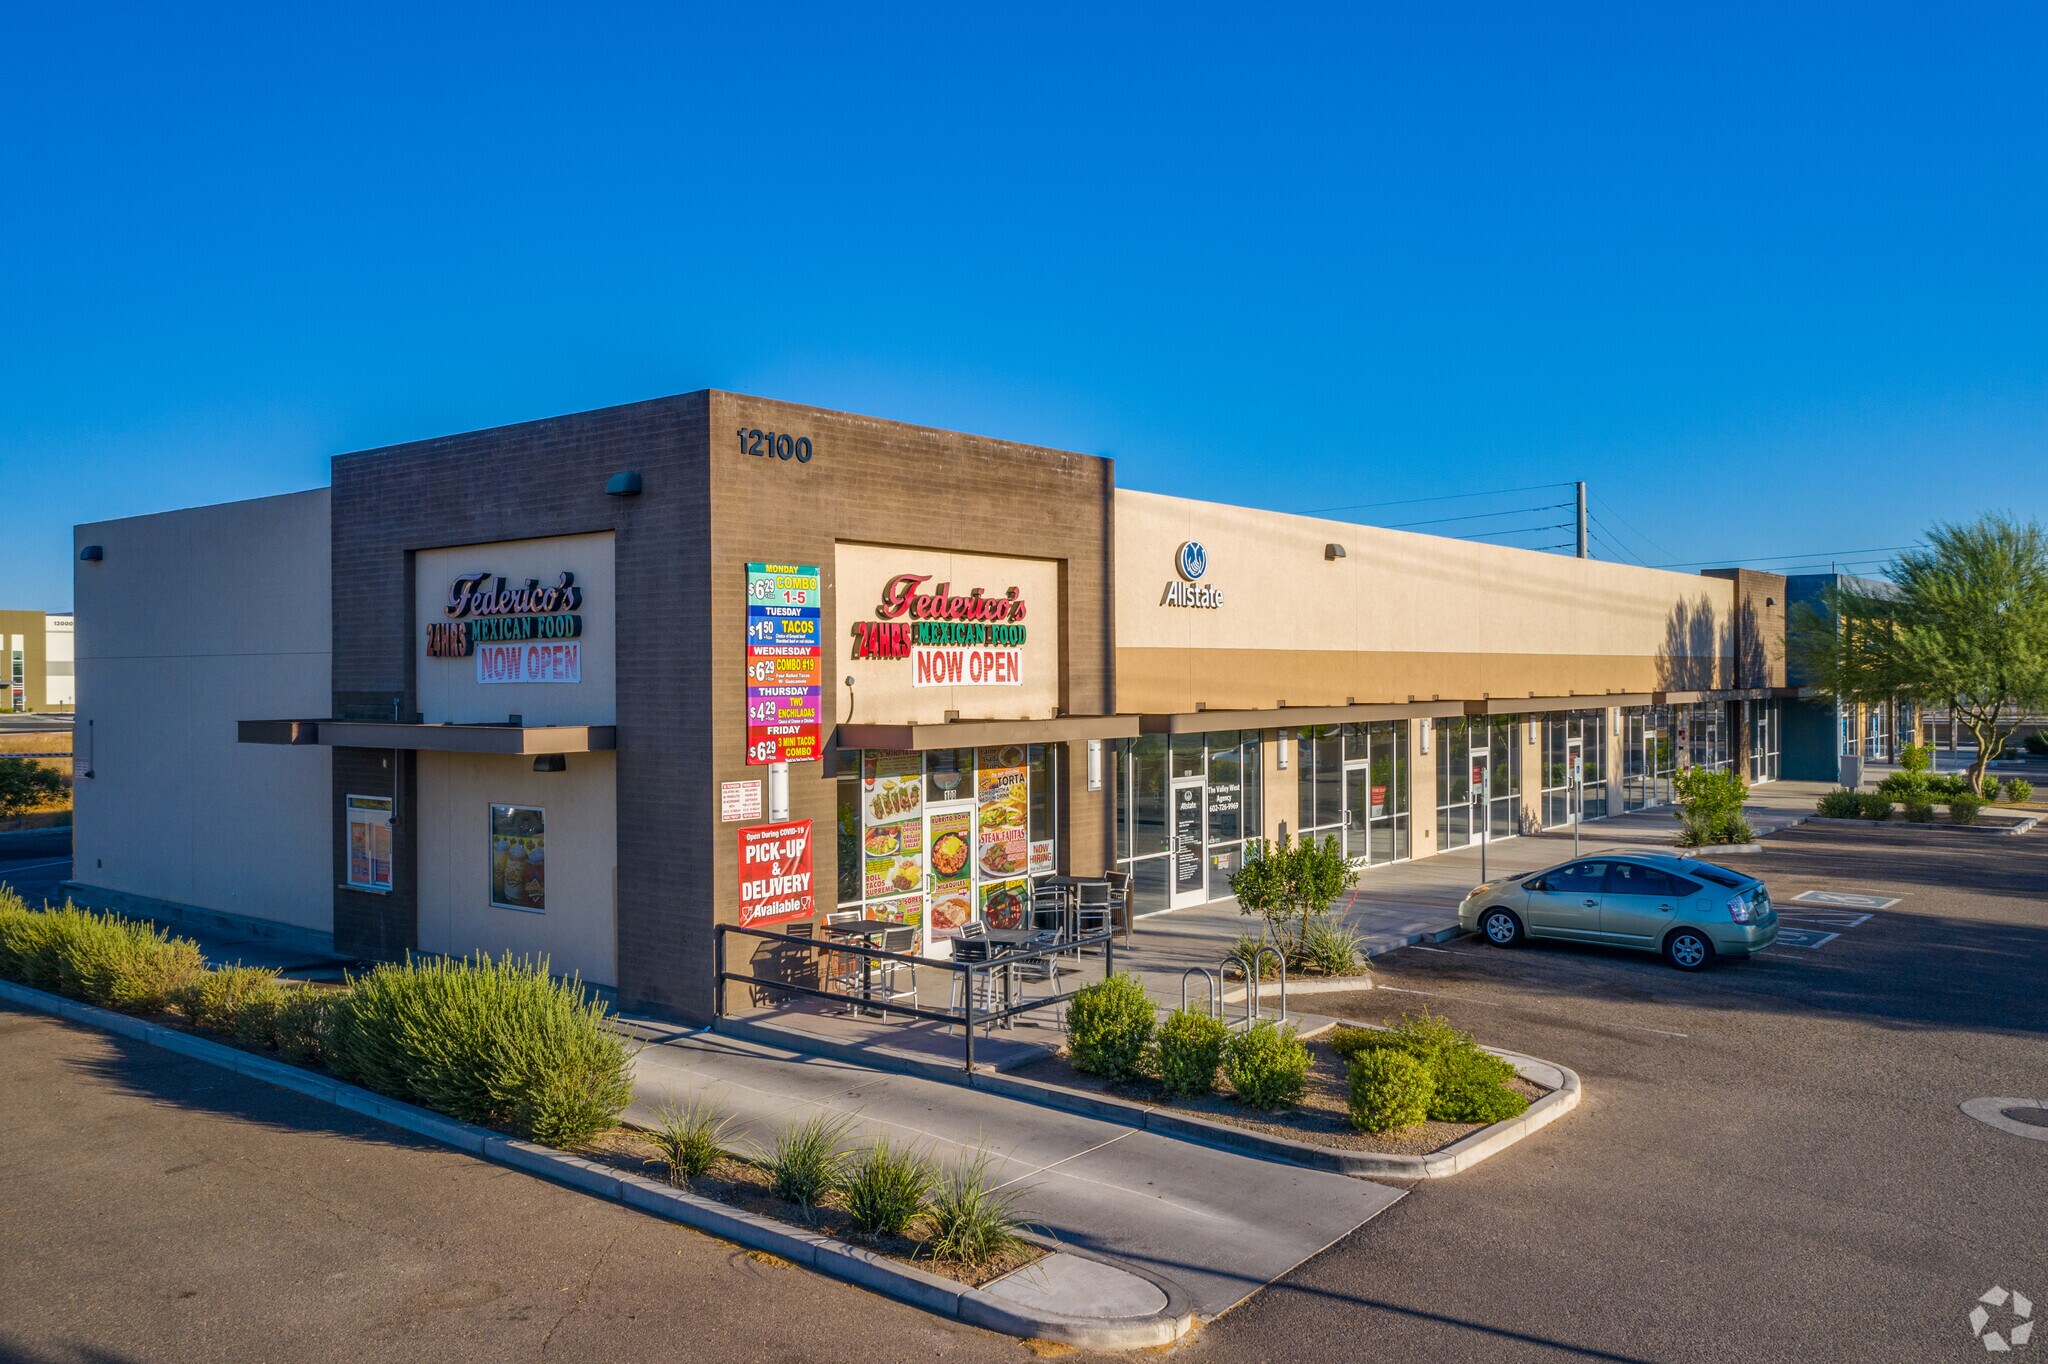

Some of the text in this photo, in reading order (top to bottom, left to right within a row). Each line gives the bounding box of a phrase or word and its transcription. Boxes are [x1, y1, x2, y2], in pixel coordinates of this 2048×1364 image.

[737, 428, 812, 463] 12100
[765, 564, 798, 574] MONDAY
[776, 576, 817, 591] COMBO
[444, 571, 581, 618] Federico's
[783, 590, 806, 605] 1-5
[876, 573, 1026, 622] Federico's
[1160, 581, 1224, 608] Allstate
[765, 607, 801, 616] TUESDAY
[471, 614, 577, 641] MEXICAN FOOD
[781, 620, 814, 634] TACOS
[916, 621, 1026, 646] MEXICAN FOOD
[427, 623, 470, 657] 24HRS
[855, 621, 911, 659] 24HRS
[753, 646, 811, 655] WEDNESDAY
[481, 645, 578, 680] NOW OPEN
[776, 658, 815, 671] COMBO #19
[917, 650, 1019, 684] NOW OPEN
[758, 686, 809, 696] THURSDAY
[789, 697, 803, 706] TWO
[778, 708, 815, 719] ENCHILADAS
[767, 726, 800, 735] FRIDAY
[778, 736, 815, 747] 3 MINI TACOS
[785, 747, 812, 756] COMBO
[997, 773, 1025, 787] TORTA
[931, 813, 969, 824] BURRITO BOWL
[746, 827, 805, 842] Open During COVID-19
[980, 828, 1025, 844] STEAK FAJITAS
[746, 838, 806, 864] PICK-UP
[1033, 843, 1049, 854] NOW
[1030, 852, 1052, 864] HIRING
[772, 862, 781, 876] &
[865, 874, 881, 882] ROLL
[866, 880, 886, 890] TACOS
[742, 872, 811, 901] DELIVERY
[866, 885, 894, 896] SUPREME
[904, 895, 922, 905] SOPES
[754, 898, 800, 918] Available
